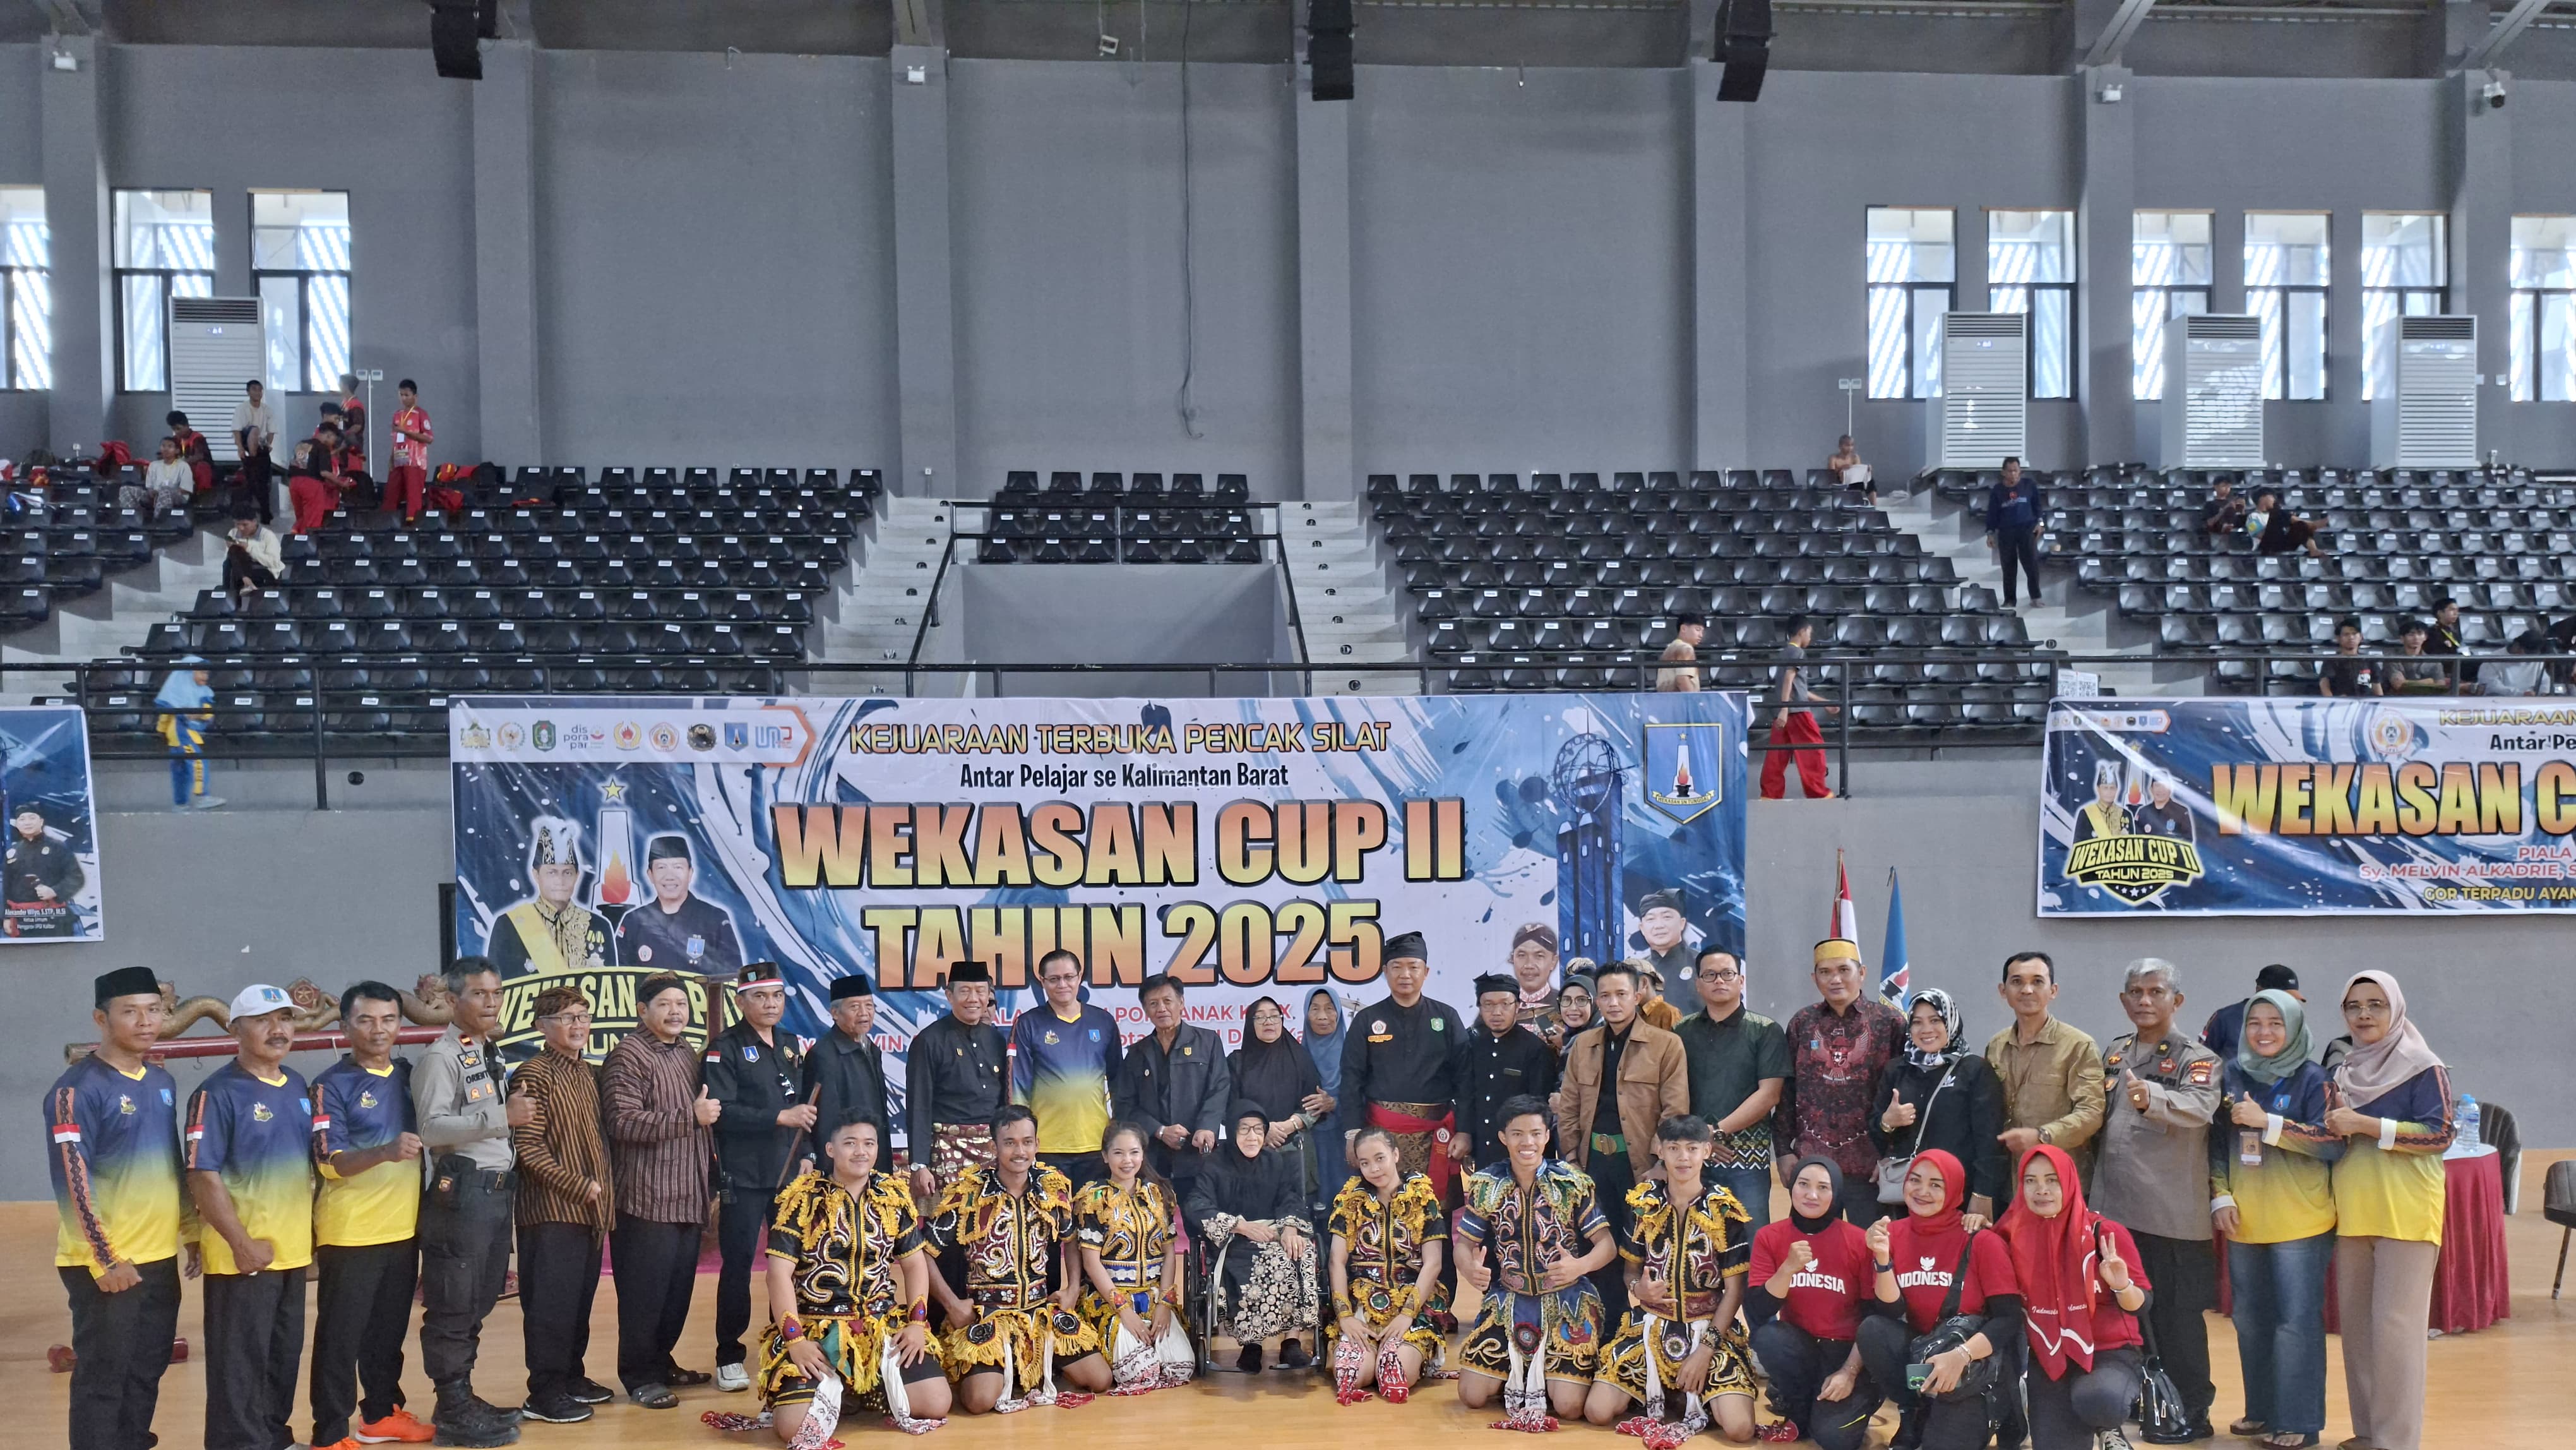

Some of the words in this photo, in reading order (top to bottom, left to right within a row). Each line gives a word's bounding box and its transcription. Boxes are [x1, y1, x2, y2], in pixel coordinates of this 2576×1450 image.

[571, 724, 587, 733] dis
[564, 734, 588, 743] pora
[850, 724, 1029, 754] KEJUARAAN
[1036, 723, 1176, 754] TERBUKA
[1184, 722, 1304, 753] PENCAK
[1312, 721, 1392, 753] SILAT
[2490, 734, 2546, 750] Antar
[570, 742, 587, 750] par
[960, 764, 1013, 788] Antar
[1020, 764, 1087, 794] Pelajar
[1093, 769, 1116, 787] se
[1123, 763, 1231, 788] Kalimantan
[1237, 762, 1289, 786] Barat
[2213, 760, 2522, 837] WEKASAN
[770, 800, 1198, 889] WEKASAN
[1215, 798, 1388, 887] CUP
[1402, 797, 1466, 883] II
[2070, 839, 2144, 872] WEKASAN
[2148, 839, 2178, 865] CUP
[2179, 844, 2198, 871] II
[2519, 847, 2572, 859] PIALA
[2095, 868, 2140, 879] TAHUN
[2141, 868, 2174, 879] 2025
[2361, 866, 2385, 880] Sy.
[2391, 865, 2460, 877] MELVIN
[2466, 864, 2563, 879] ALKADRIE,
[2424, 888, 2458, 901] GOR
[2462, 887, 2536, 900] TERPADU
[861, 903, 1147, 991] TAHUN
[1163, 898, 1386, 987] 2025
